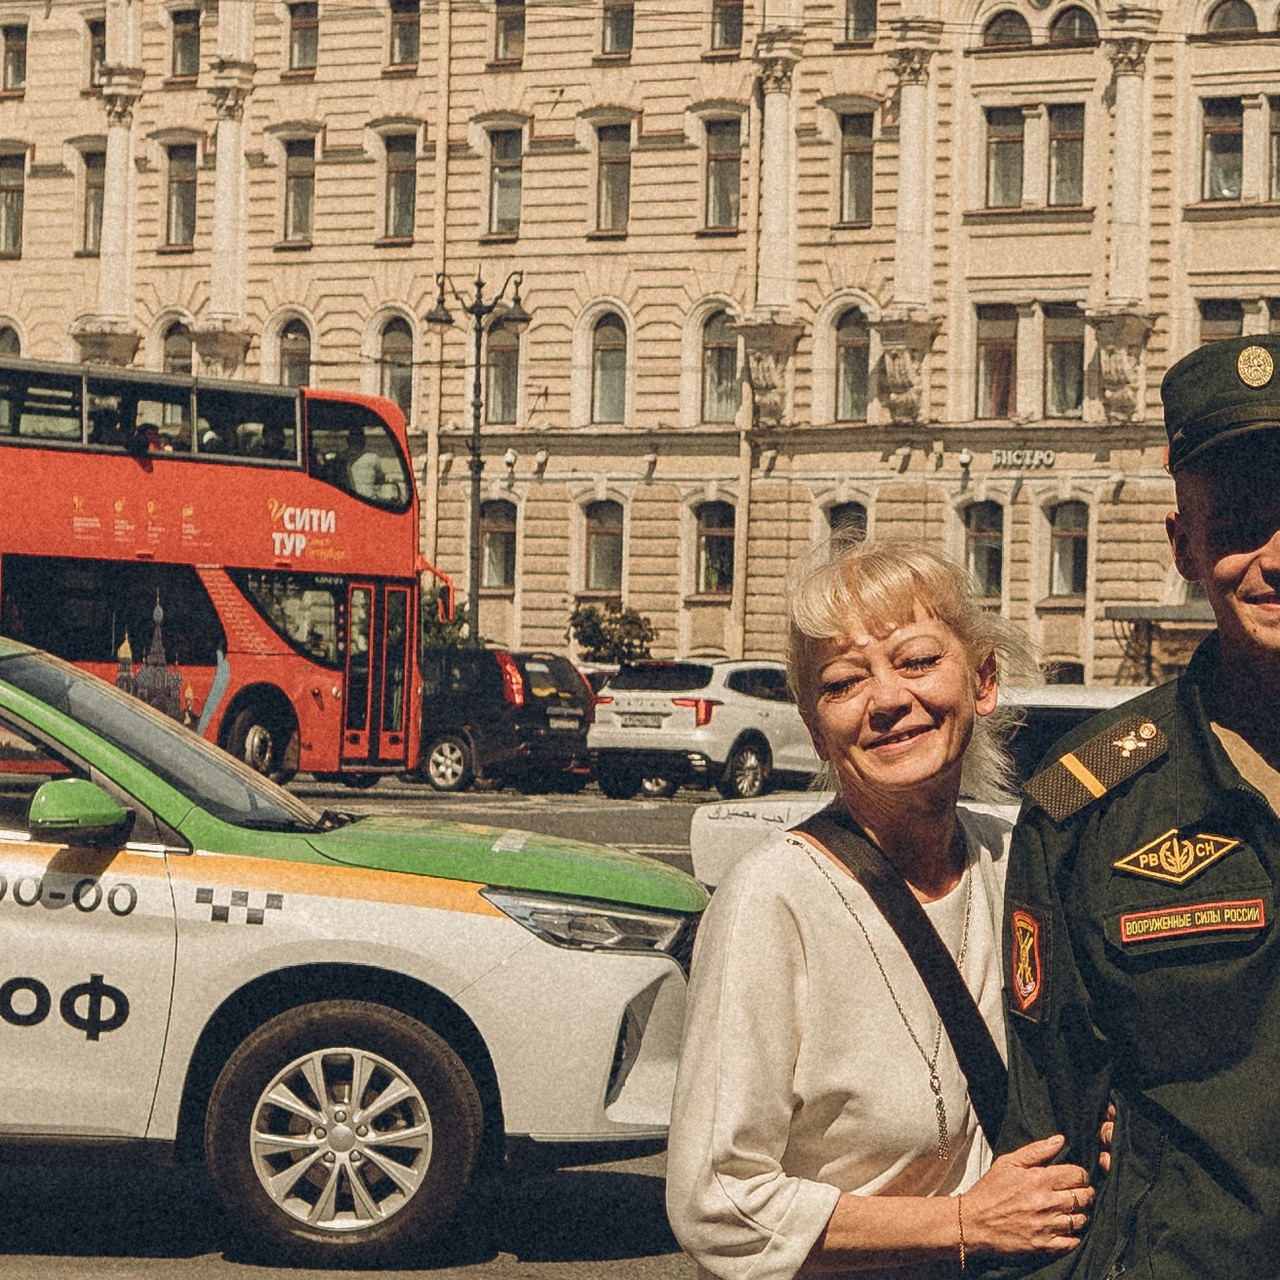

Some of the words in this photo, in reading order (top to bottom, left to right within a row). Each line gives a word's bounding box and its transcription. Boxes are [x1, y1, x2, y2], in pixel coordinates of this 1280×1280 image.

[992, 449, 1055, 469] БИСТРО
[283, 507, 336, 534] СИТИ
[271, 531, 307, 557] ТУР
[1139, 852, 1159, 868] РВ
[1195, 840, 1216, 857] СН
[0, 875, 138, 917] 0-00
[1125, 913, 1193, 936] ВООРУЖЕННЫЕ
[1194, 910, 1221, 926] СИЛЫ
[1223, 906, 1261, 923] РОССИИ
